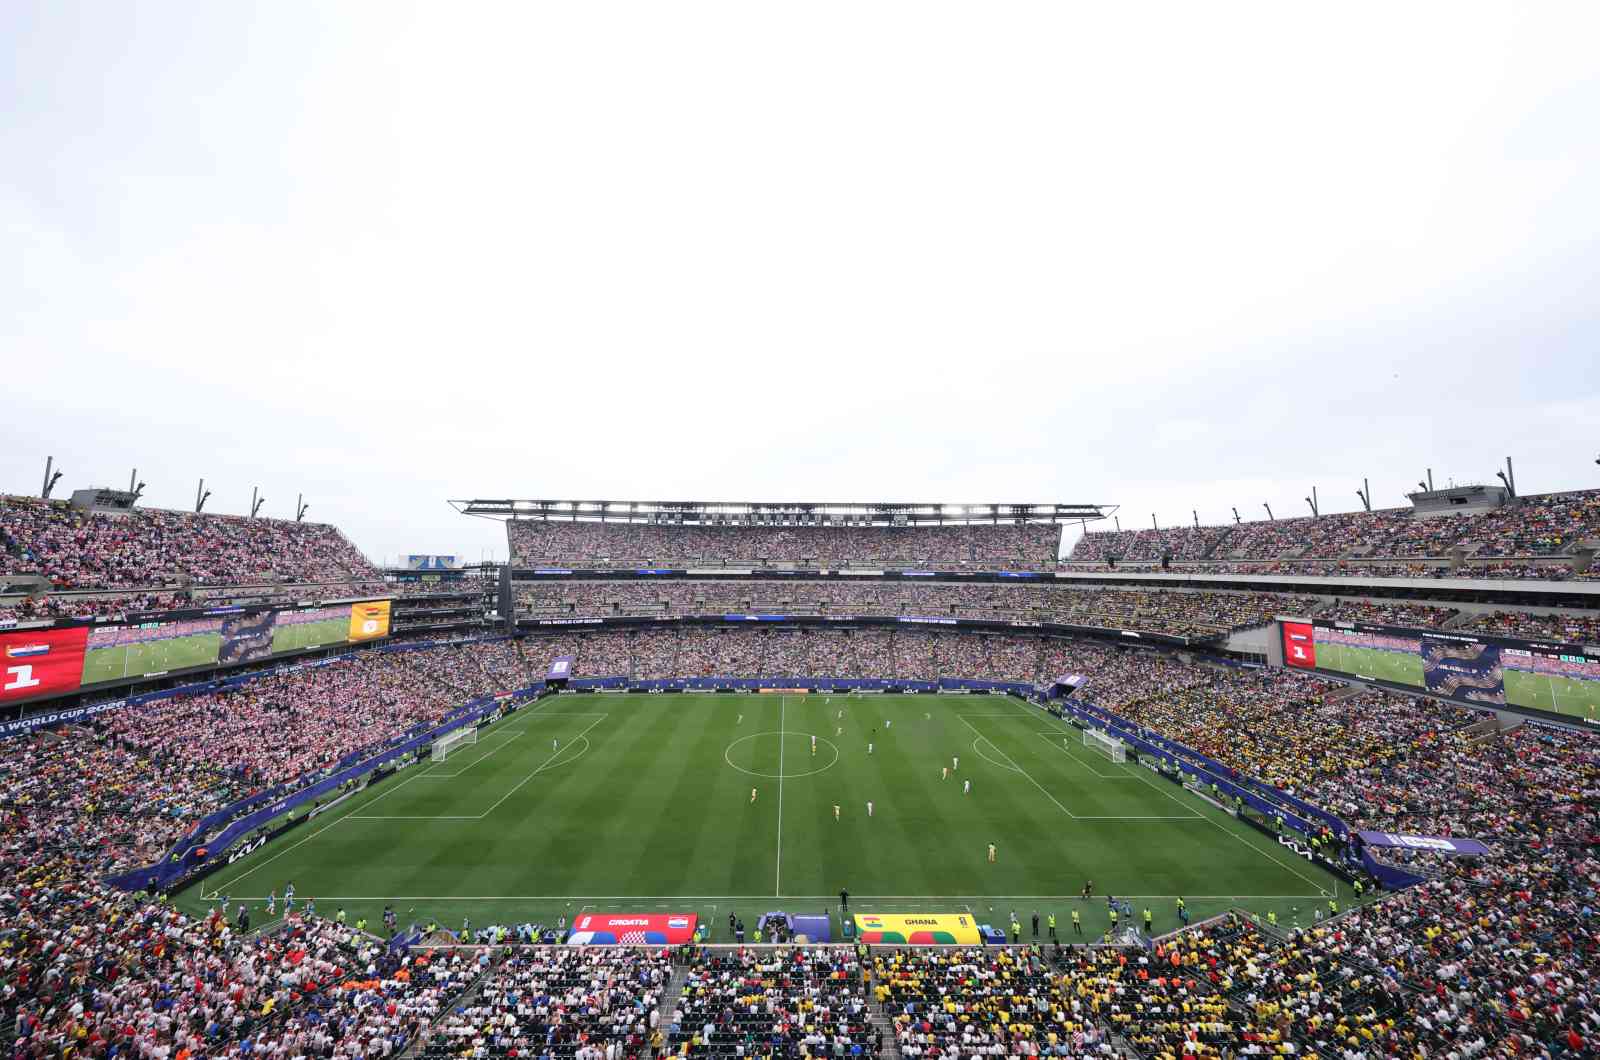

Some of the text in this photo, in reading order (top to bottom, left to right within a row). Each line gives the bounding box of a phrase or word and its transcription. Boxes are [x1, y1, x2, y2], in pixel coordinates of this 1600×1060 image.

[1293, 646, 1307, 659] 1
[4, 664, 40, 690] 1
[8, 715, 57, 731] WORLD
[60, 709, 85, 720] CUP
[86, 700, 126, 715] 2026
